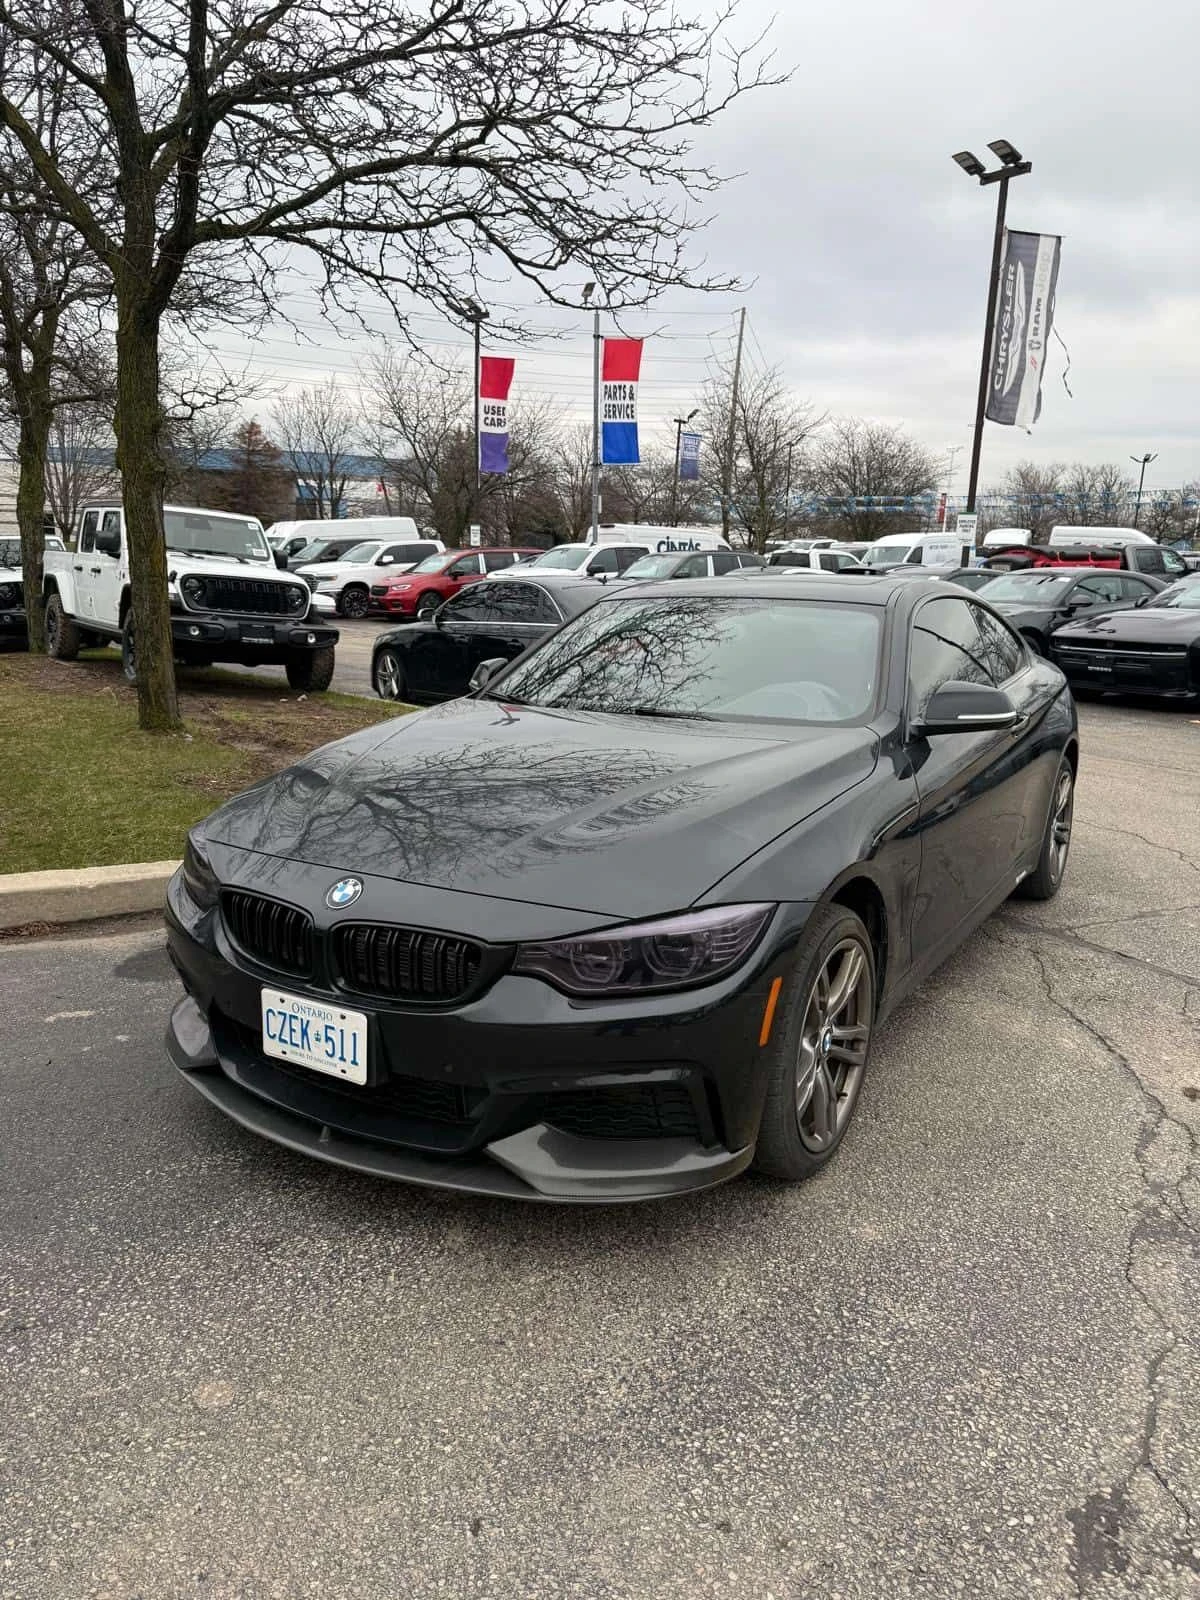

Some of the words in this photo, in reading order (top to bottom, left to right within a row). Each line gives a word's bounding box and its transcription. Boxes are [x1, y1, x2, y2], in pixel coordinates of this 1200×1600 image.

[994, 263, 1015, 391] CHRYSLER
[1032, 297, 1042, 336] RAM
[603, 384, 627, 400] PARTS
[628, 386, 635, 399] &
[603, 404, 635, 419] SERVICE
[291, 1002, 333, 1021] ONTARIO
[265, 1008, 312, 1052] CZEK
[324, 1024, 359, 1066] 511
